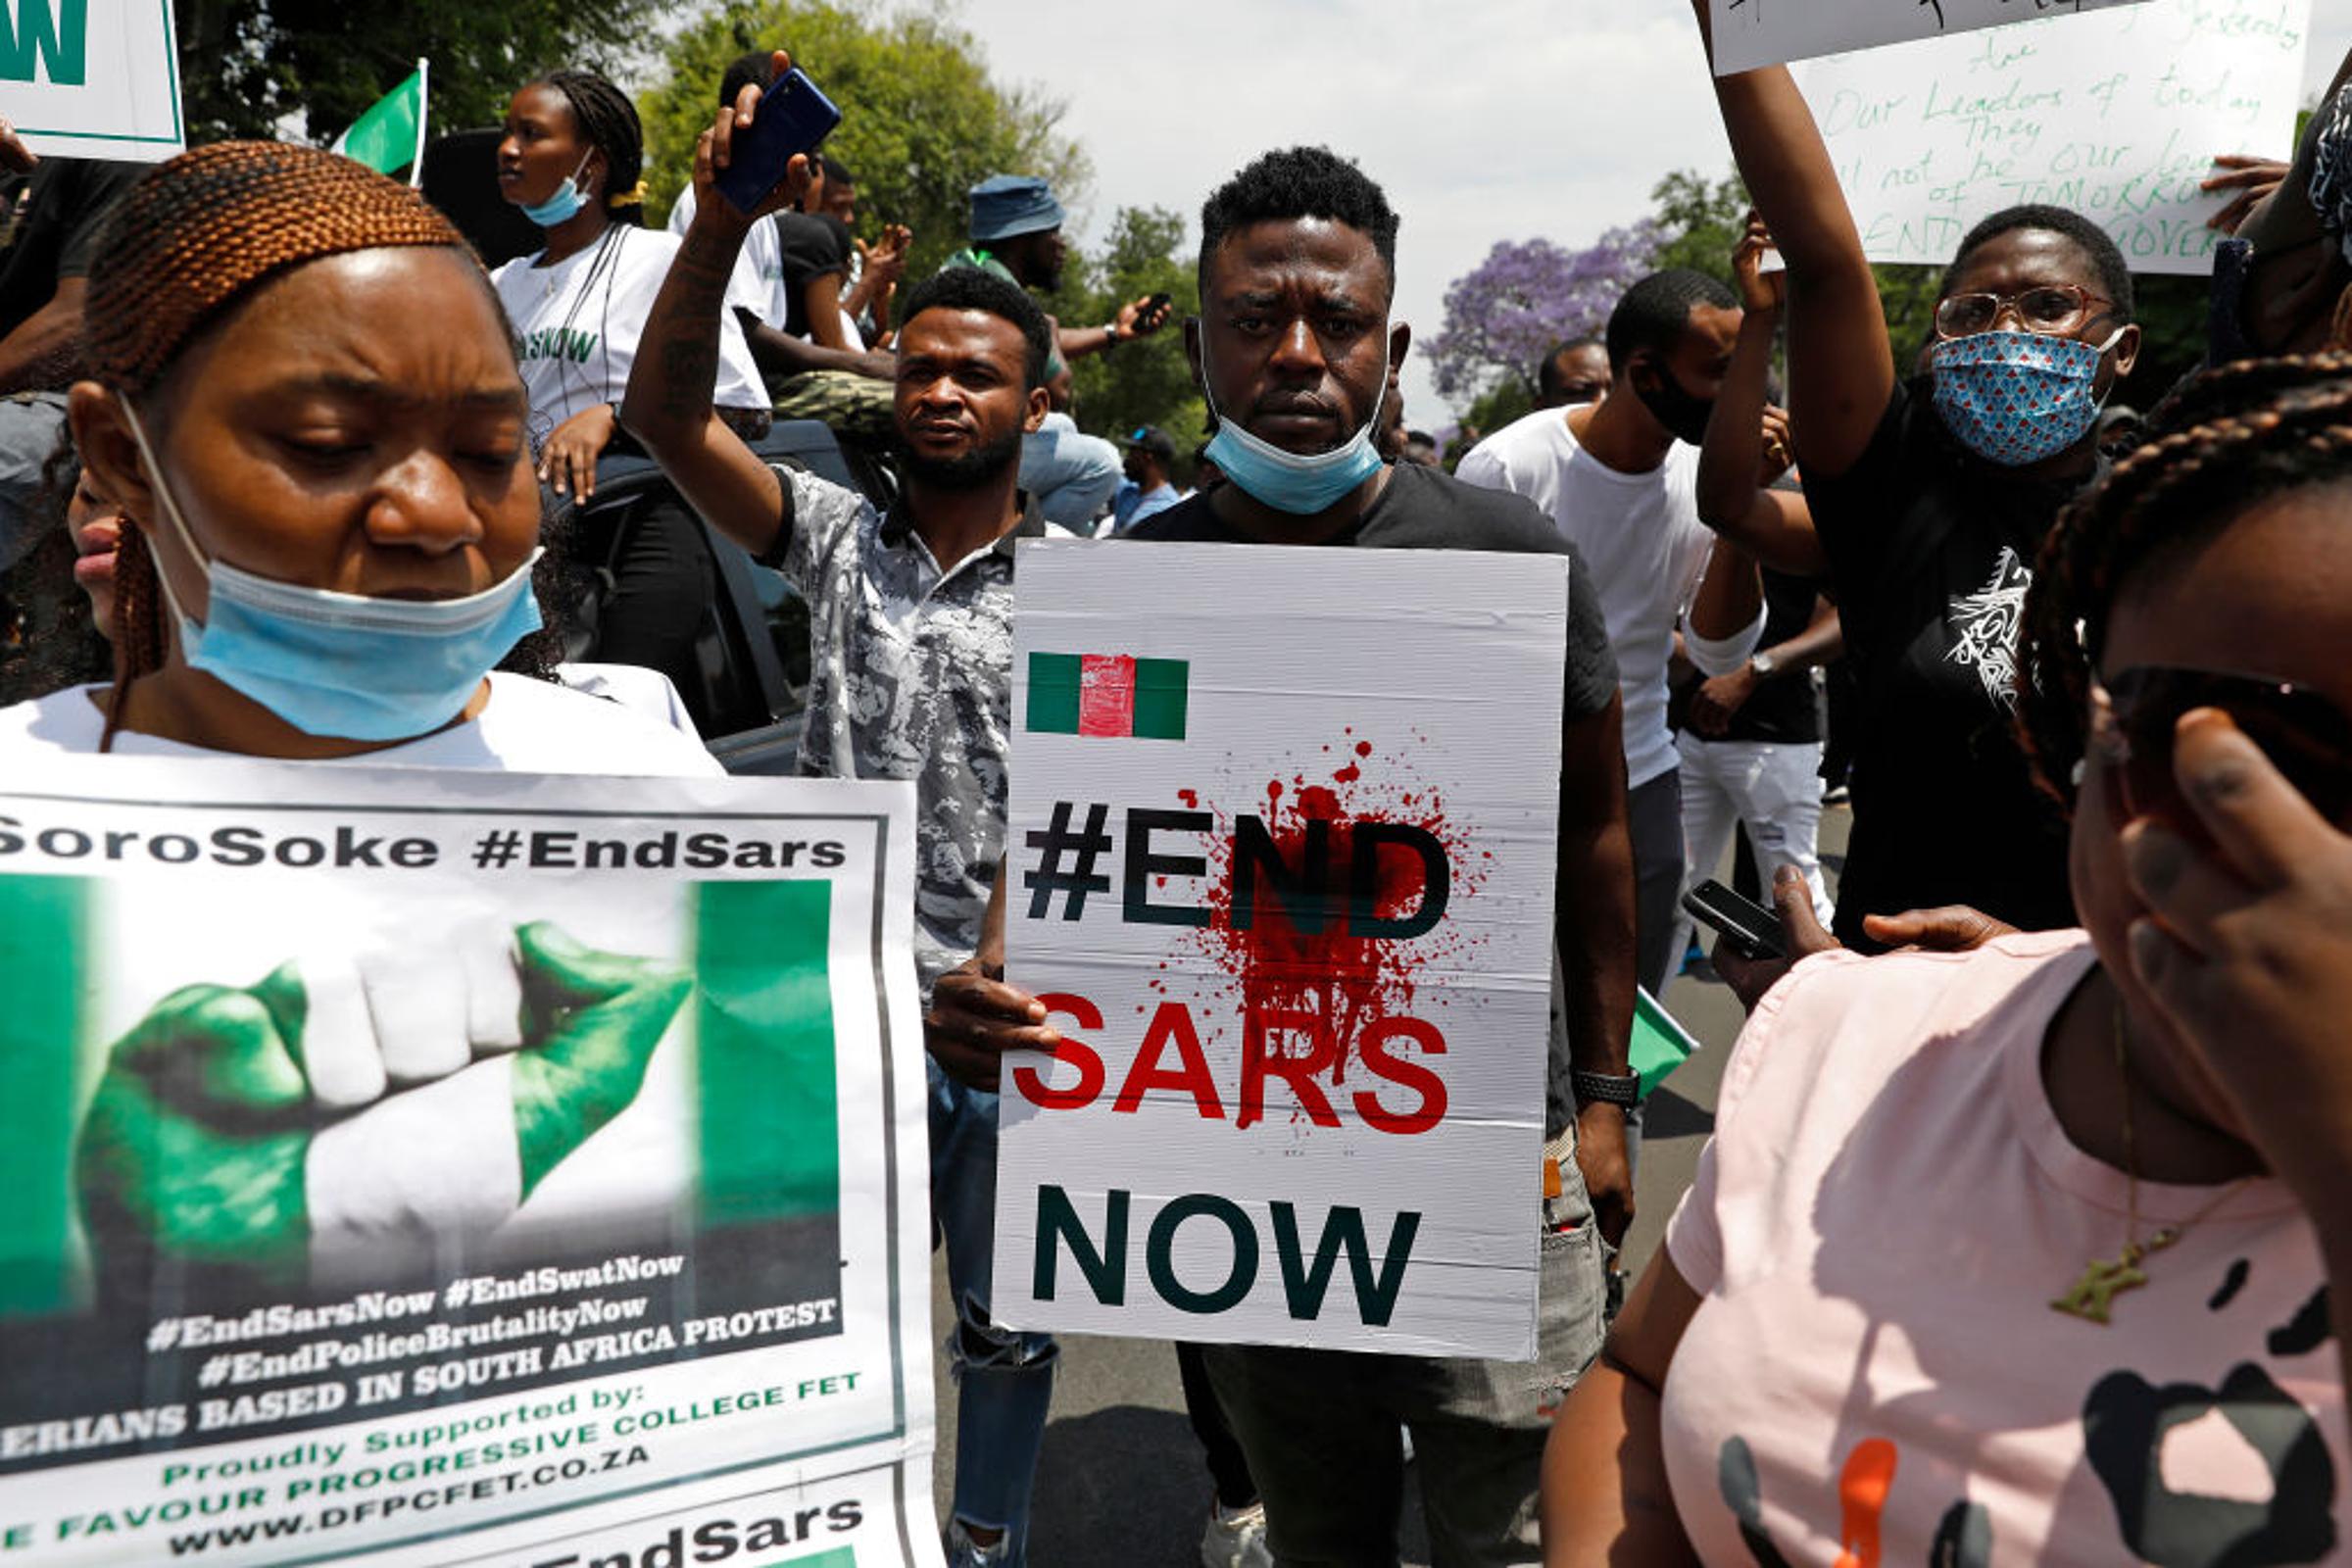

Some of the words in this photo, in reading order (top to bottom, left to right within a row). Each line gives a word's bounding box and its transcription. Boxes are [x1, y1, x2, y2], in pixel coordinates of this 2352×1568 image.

[471, 830, 847, 869] #EndSars
[1023, 801, 1451, 941] #END
[1011, 992, 1449, 1136] SARS
[145, 1289, 437, 1353] #EndSarsNow
[444, 1254, 685, 1309] #EndSwatNow
[1031, 1183, 1423, 1329] NOW
[197, 1295, 648, 1389] #EndPoliceBrutalityNow
[198, 1381, 347, 1433] BASED
[356, 1371, 403, 1407] IN
[413, 1350, 544, 1397] SOUTH
[550, 1324, 677, 1369] AFRICA
[683, 1298, 838, 1346] PROTEST
[57, 1487, 266, 1541] FAVOUR
[286, 1423, 599, 1500] PROGRESSIVE
[612, 1386, 784, 1436] COLLEGE
[797, 1372, 862, 1400] FET
[163, 1442, 348, 1488] Proudly
[363, 1396, 577, 1454] Supported
[592, 1384, 644, 1411] by:
[169, 1444, 650, 1556] WWW.DFPCFET.CO.ZA
